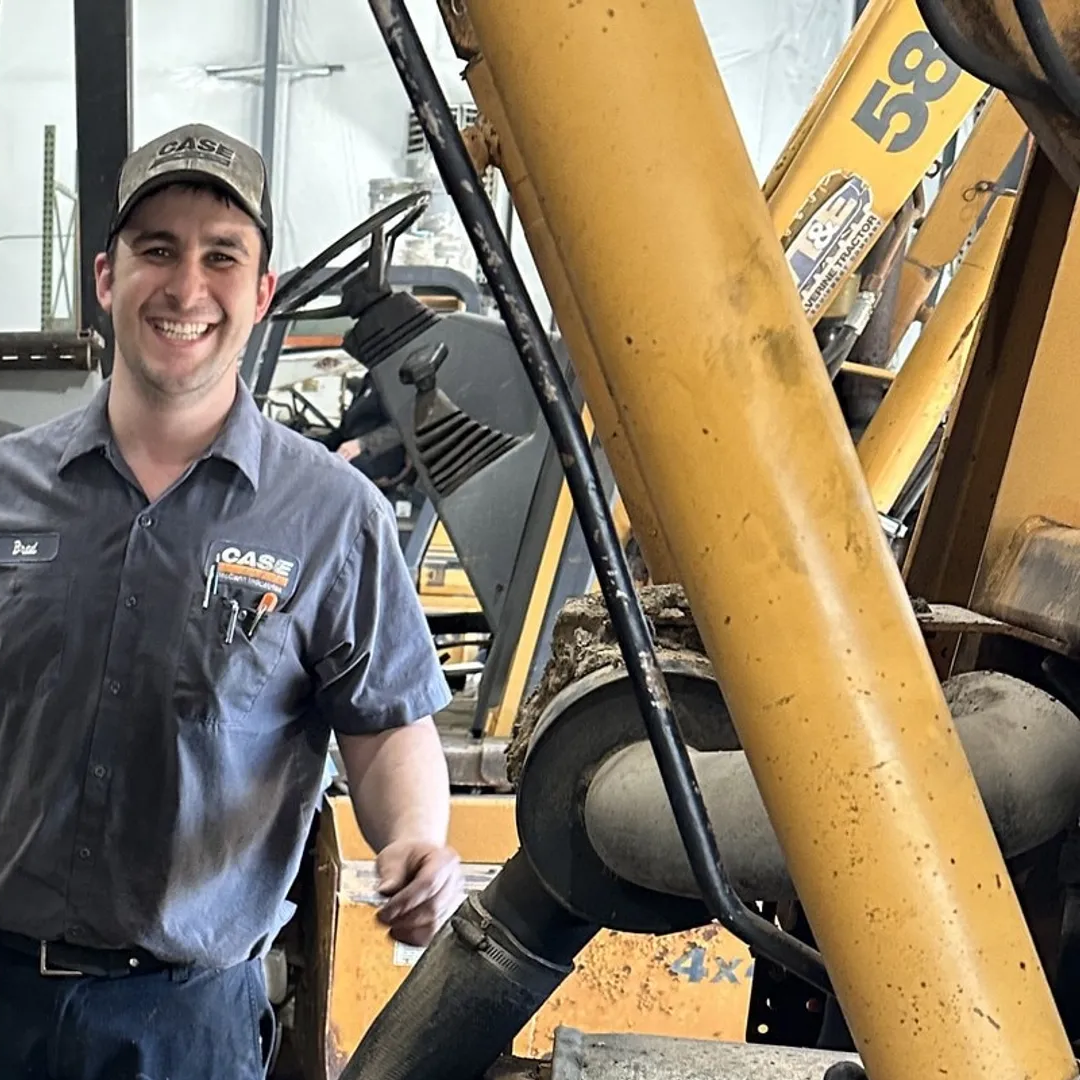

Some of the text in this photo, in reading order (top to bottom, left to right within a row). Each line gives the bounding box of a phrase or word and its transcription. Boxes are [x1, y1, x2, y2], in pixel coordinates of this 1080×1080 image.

[158, 137, 235, 160] CASE
[835, 214, 878, 271] TRACTOR
[12, 540, 39, 555] Brad
[221, 547, 294, 576] CASE
